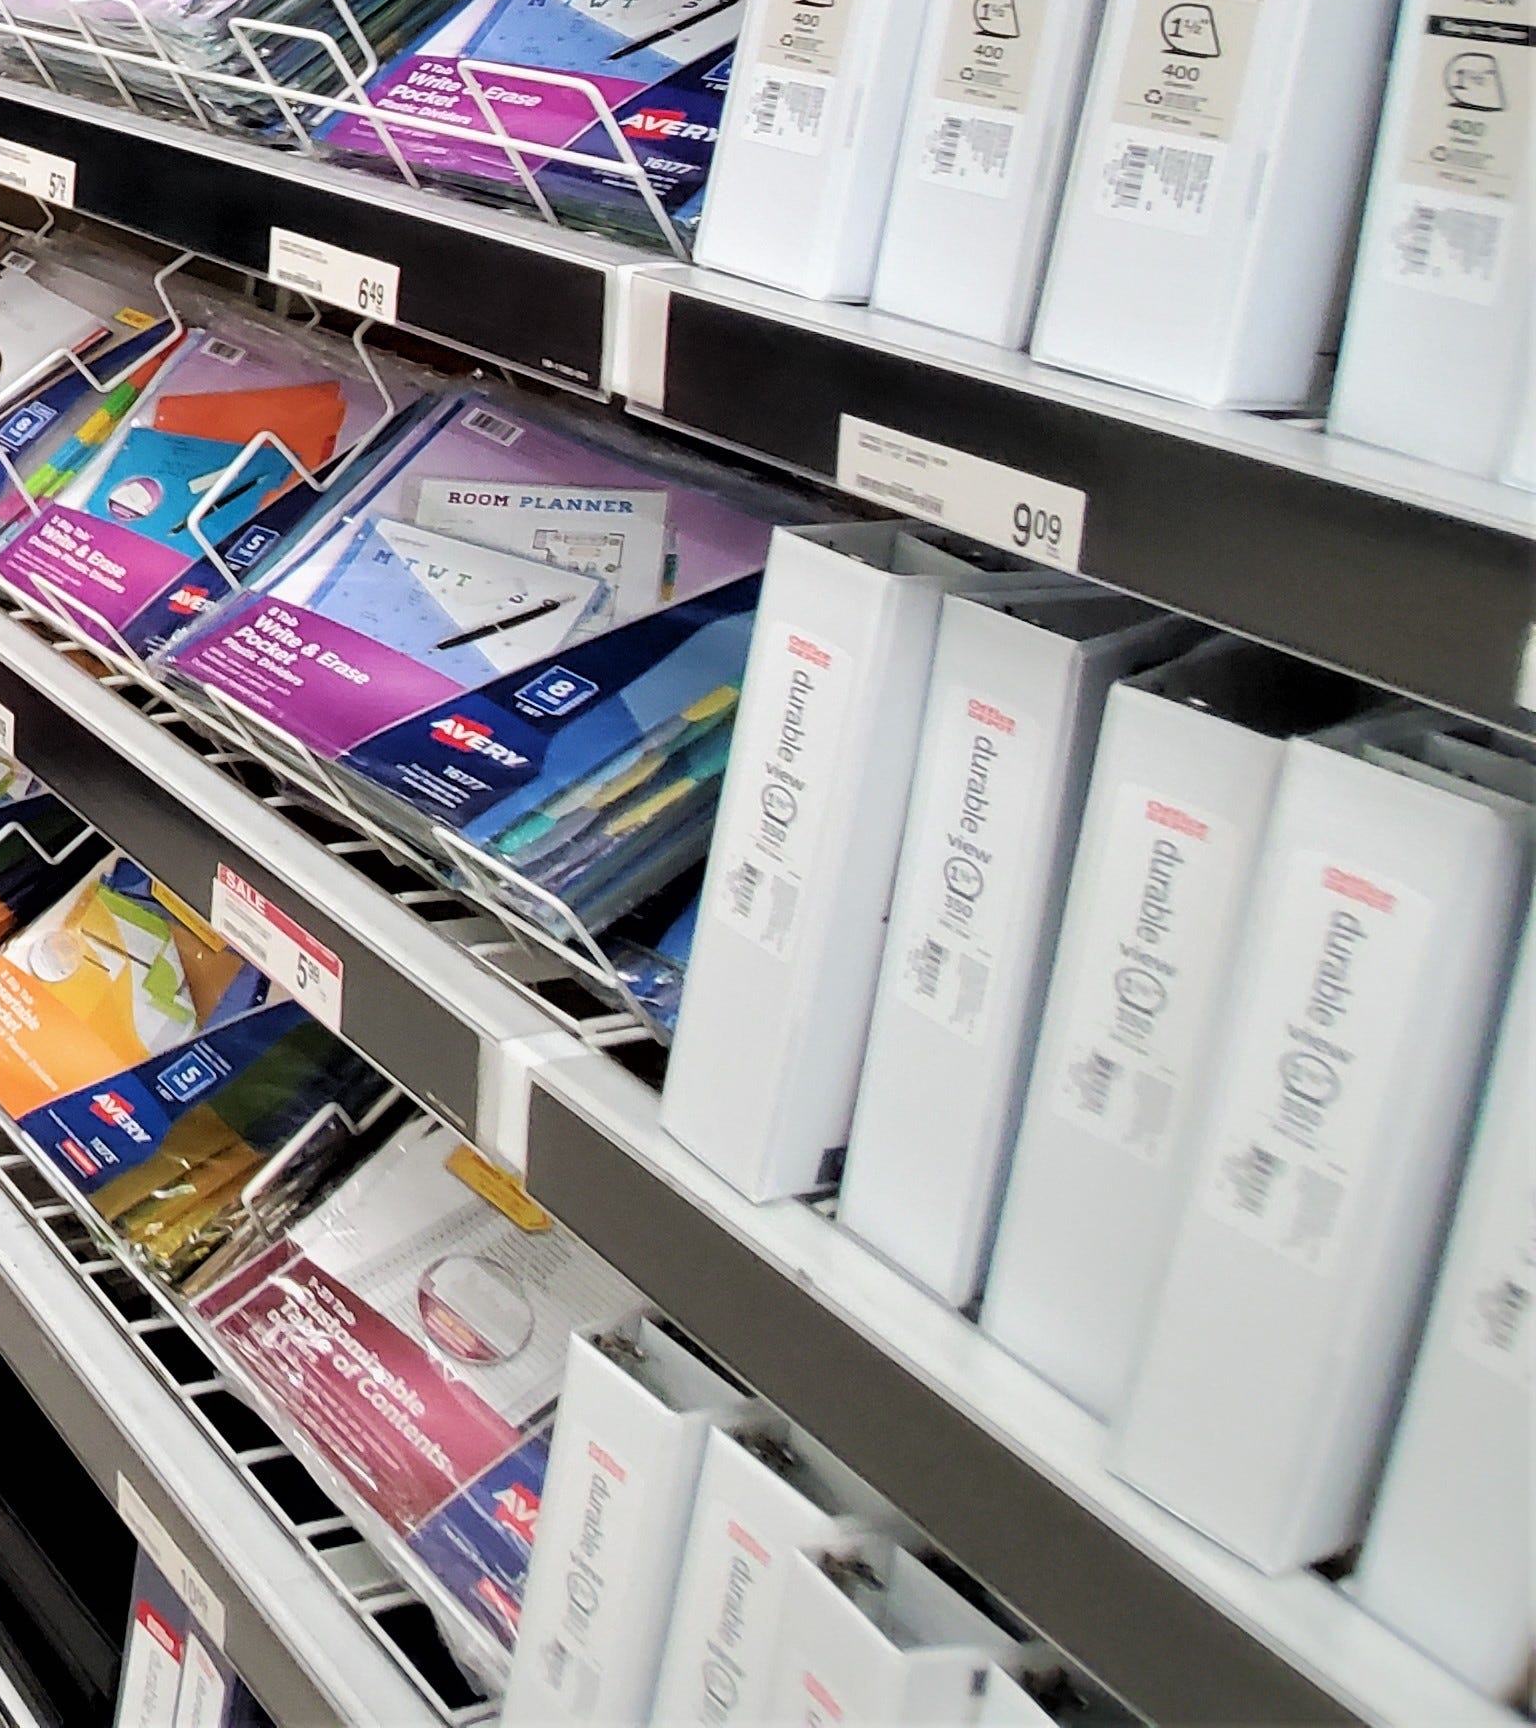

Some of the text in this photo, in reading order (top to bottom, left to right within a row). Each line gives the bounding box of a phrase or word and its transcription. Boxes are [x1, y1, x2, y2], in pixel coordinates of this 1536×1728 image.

[792, 12, 820, 28] 400
[973, 44, 1004, 60] 400
[1162, 64, 1200, 82] 400
[388, 84, 461, 108] Pocket
[406, 71, 543, 107] Write Erase
[619, 114, 719, 143] AVERY
[1448, 118, 1486, 135] 400
[358, 279, 384, 311] 649
[448, 491, 634, 515] ROOM PLANNER
[1012, 502, 1062, 547] 909
[40, 523, 127, 578] Write & Erase
[372, 550, 391, 564] M
[426, 565, 450, 580] W
[455, 573, 473, 587] T
[277, 611, 298, 628] Tab
[222, 636, 259, 662] Plastic
[256, 657, 305, 687] Dividers
[235, 627, 298, 666] Pocket
[253, 616, 301, 650] Write
[301, 643, 322, 658] &
[315, 653, 370, 686] Erase
[777, 668, 817, 762] durable
[430, 717, 529, 768] AVERY
[443, 765, 494, 792] 16177
[960, 735, 999, 836] durable
[224, 870, 267, 915] SALE
[1136, 838, 1186, 946] durable
[1305, 910, 1369, 1029] durable
[92, 1092, 152, 1144] AVERY
[332, 1353, 362, 1380] of
[357, 1376, 454, 1473] Contents
[580, 1472, 611, 1561] durable
